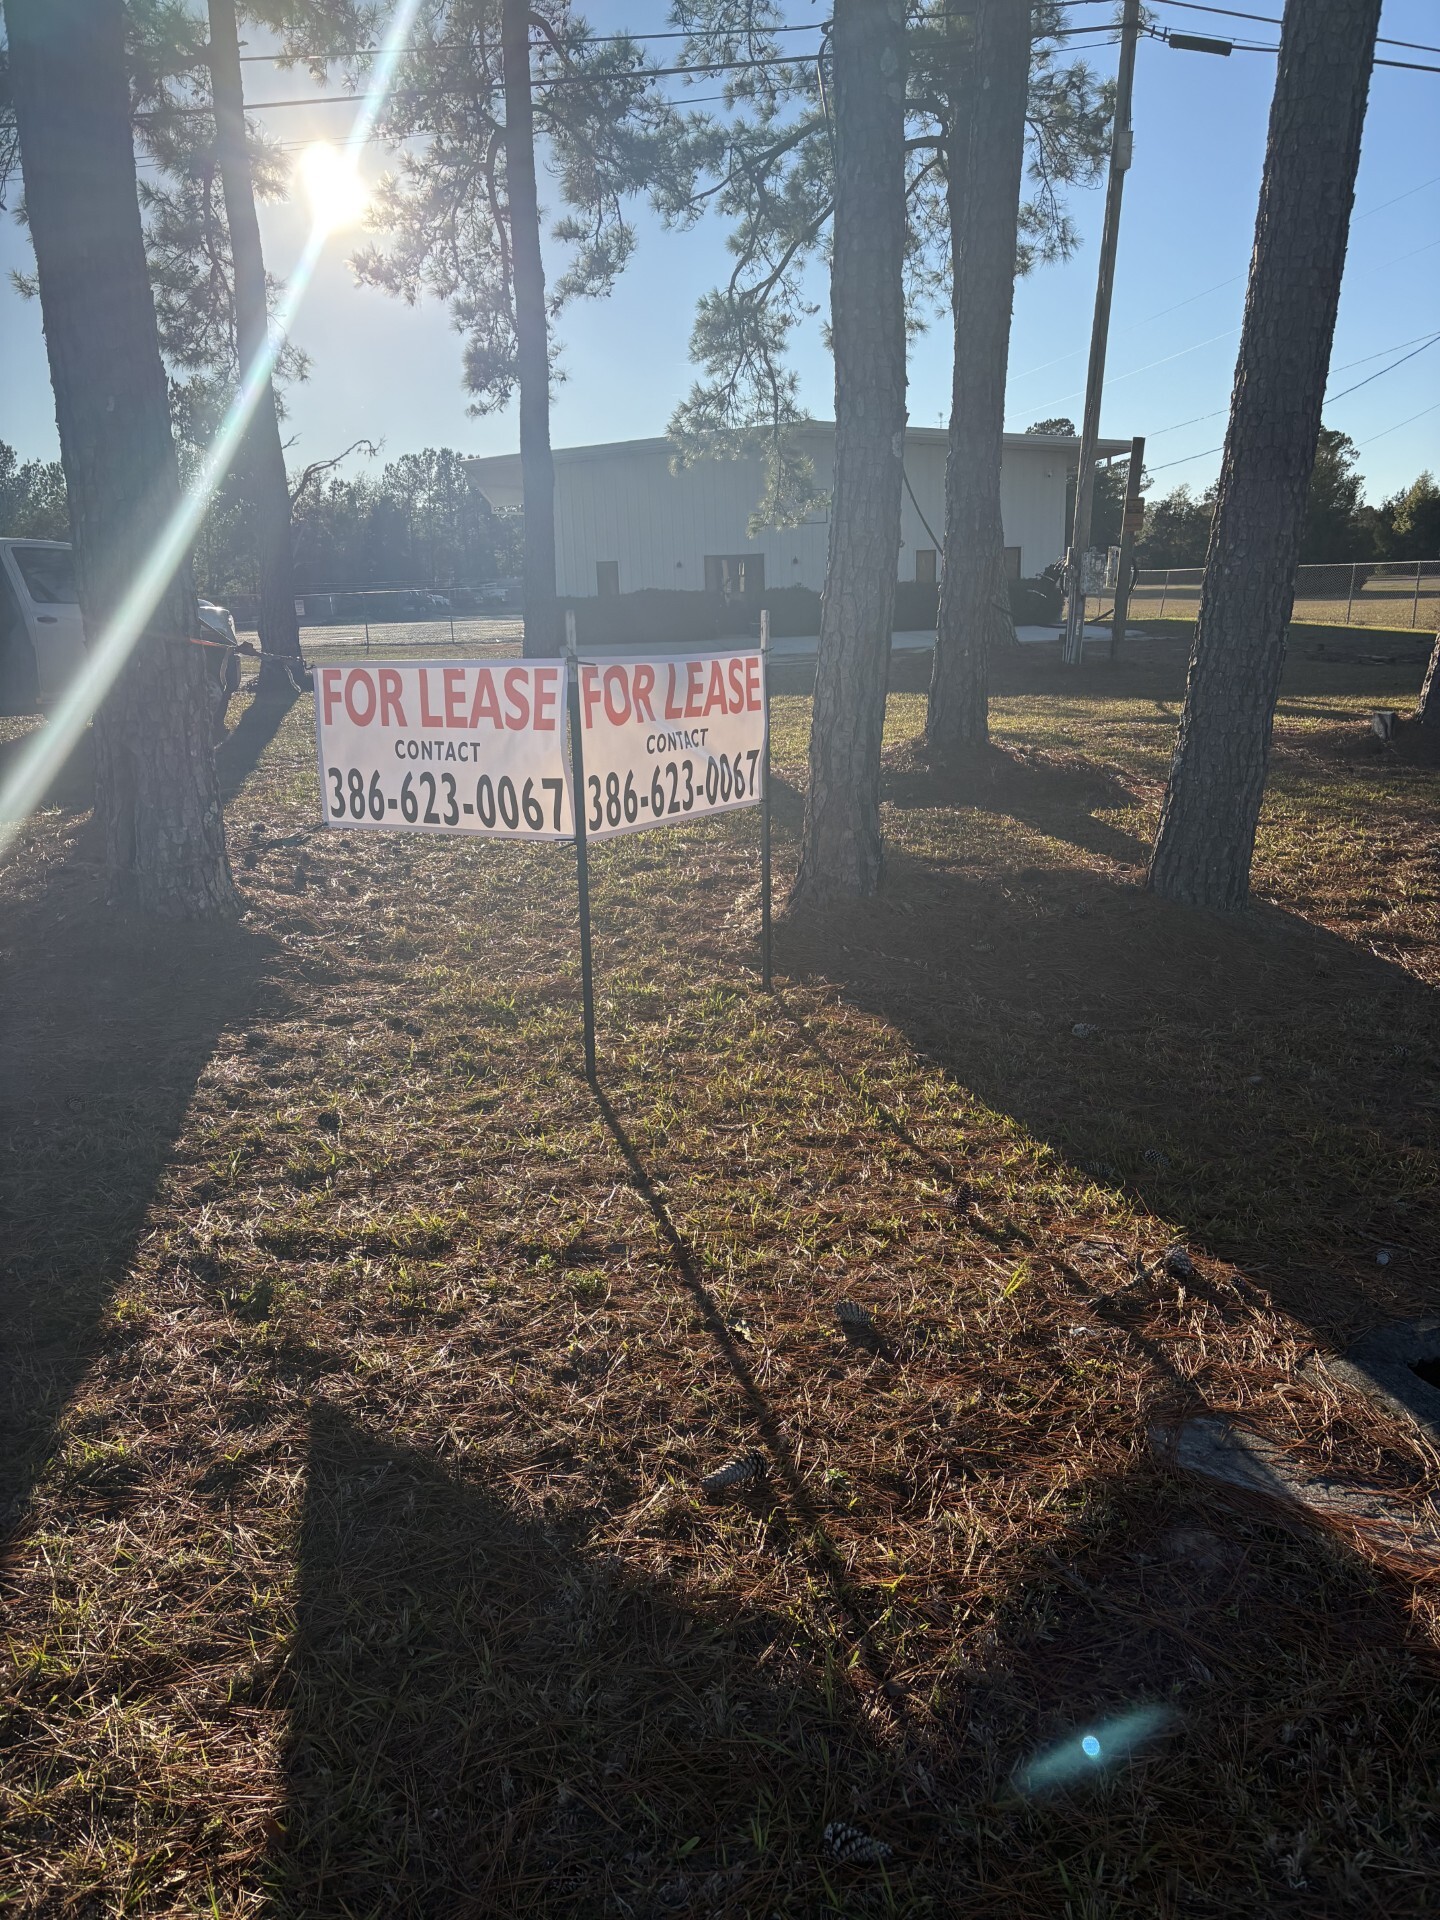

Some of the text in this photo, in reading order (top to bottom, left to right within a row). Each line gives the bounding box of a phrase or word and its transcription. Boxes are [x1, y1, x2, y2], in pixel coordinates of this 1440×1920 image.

[322, 667, 558, 731] FOR LEASE
[582, 657, 762, 729] FOR LEASE
[394, 739, 481, 762] CONTACT
[646, 728, 709, 754] CONTACT
[327, 767, 563, 832] 386-623-0067
[588, 749, 760, 831] 386-623-0067
